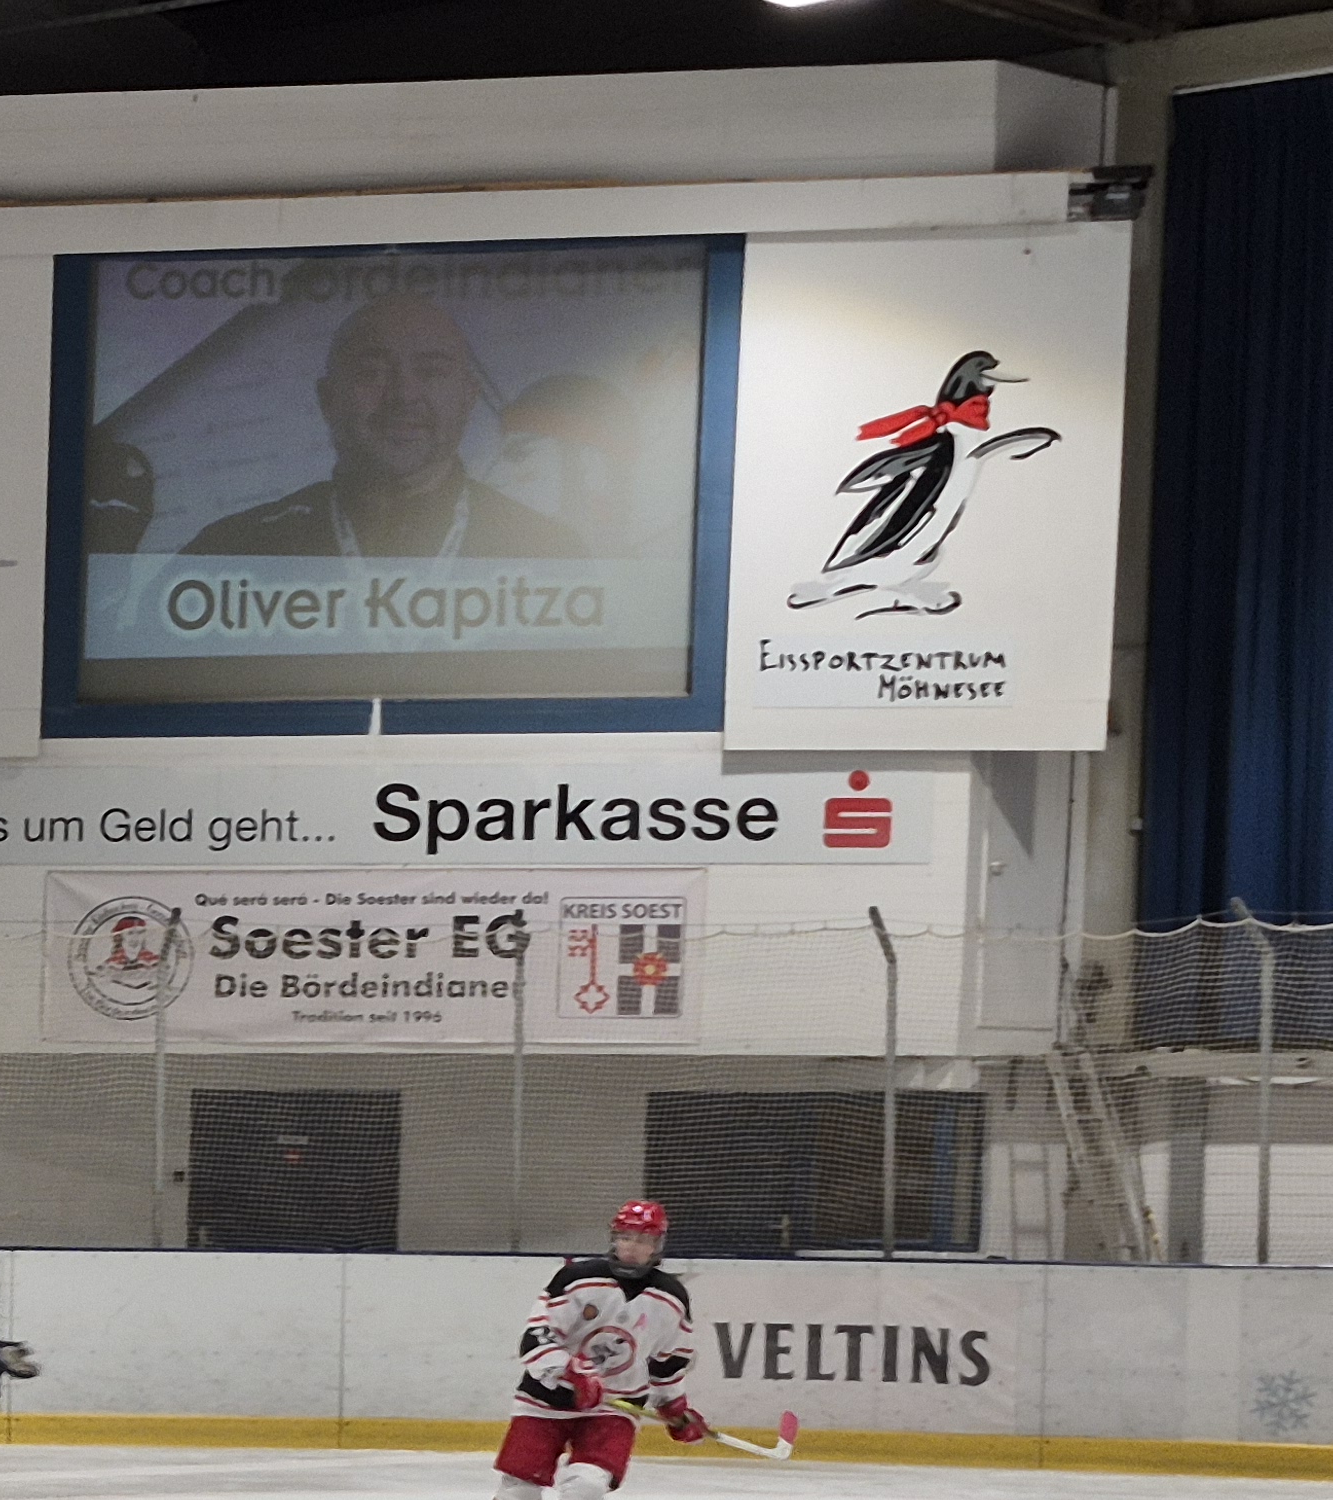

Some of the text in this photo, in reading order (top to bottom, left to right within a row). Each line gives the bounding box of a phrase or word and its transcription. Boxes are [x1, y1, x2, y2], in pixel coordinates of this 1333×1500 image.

[126, 262, 276, 300] Coach
[167, 577, 605, 640] Oliver Kapitza
[24, 816, 84, 842] um
[99, 807, 193, 843] Geld
[207, 807, 336, 851] geht...
[374, 783, 779, 854] Sparkasse
[325, 892, 352, 906] Die
[357, 892, 417, 906] Soester
[421, 891, 456, 905] sind
[460, 891, 517, 905] wieder
[563, 903, 683, 919] KREIS SOEST
[209, 914, 531, 959] Soester EG
[214, 973, 268, 998] Die
[713, 1321, 991, 1387] VELTINS
